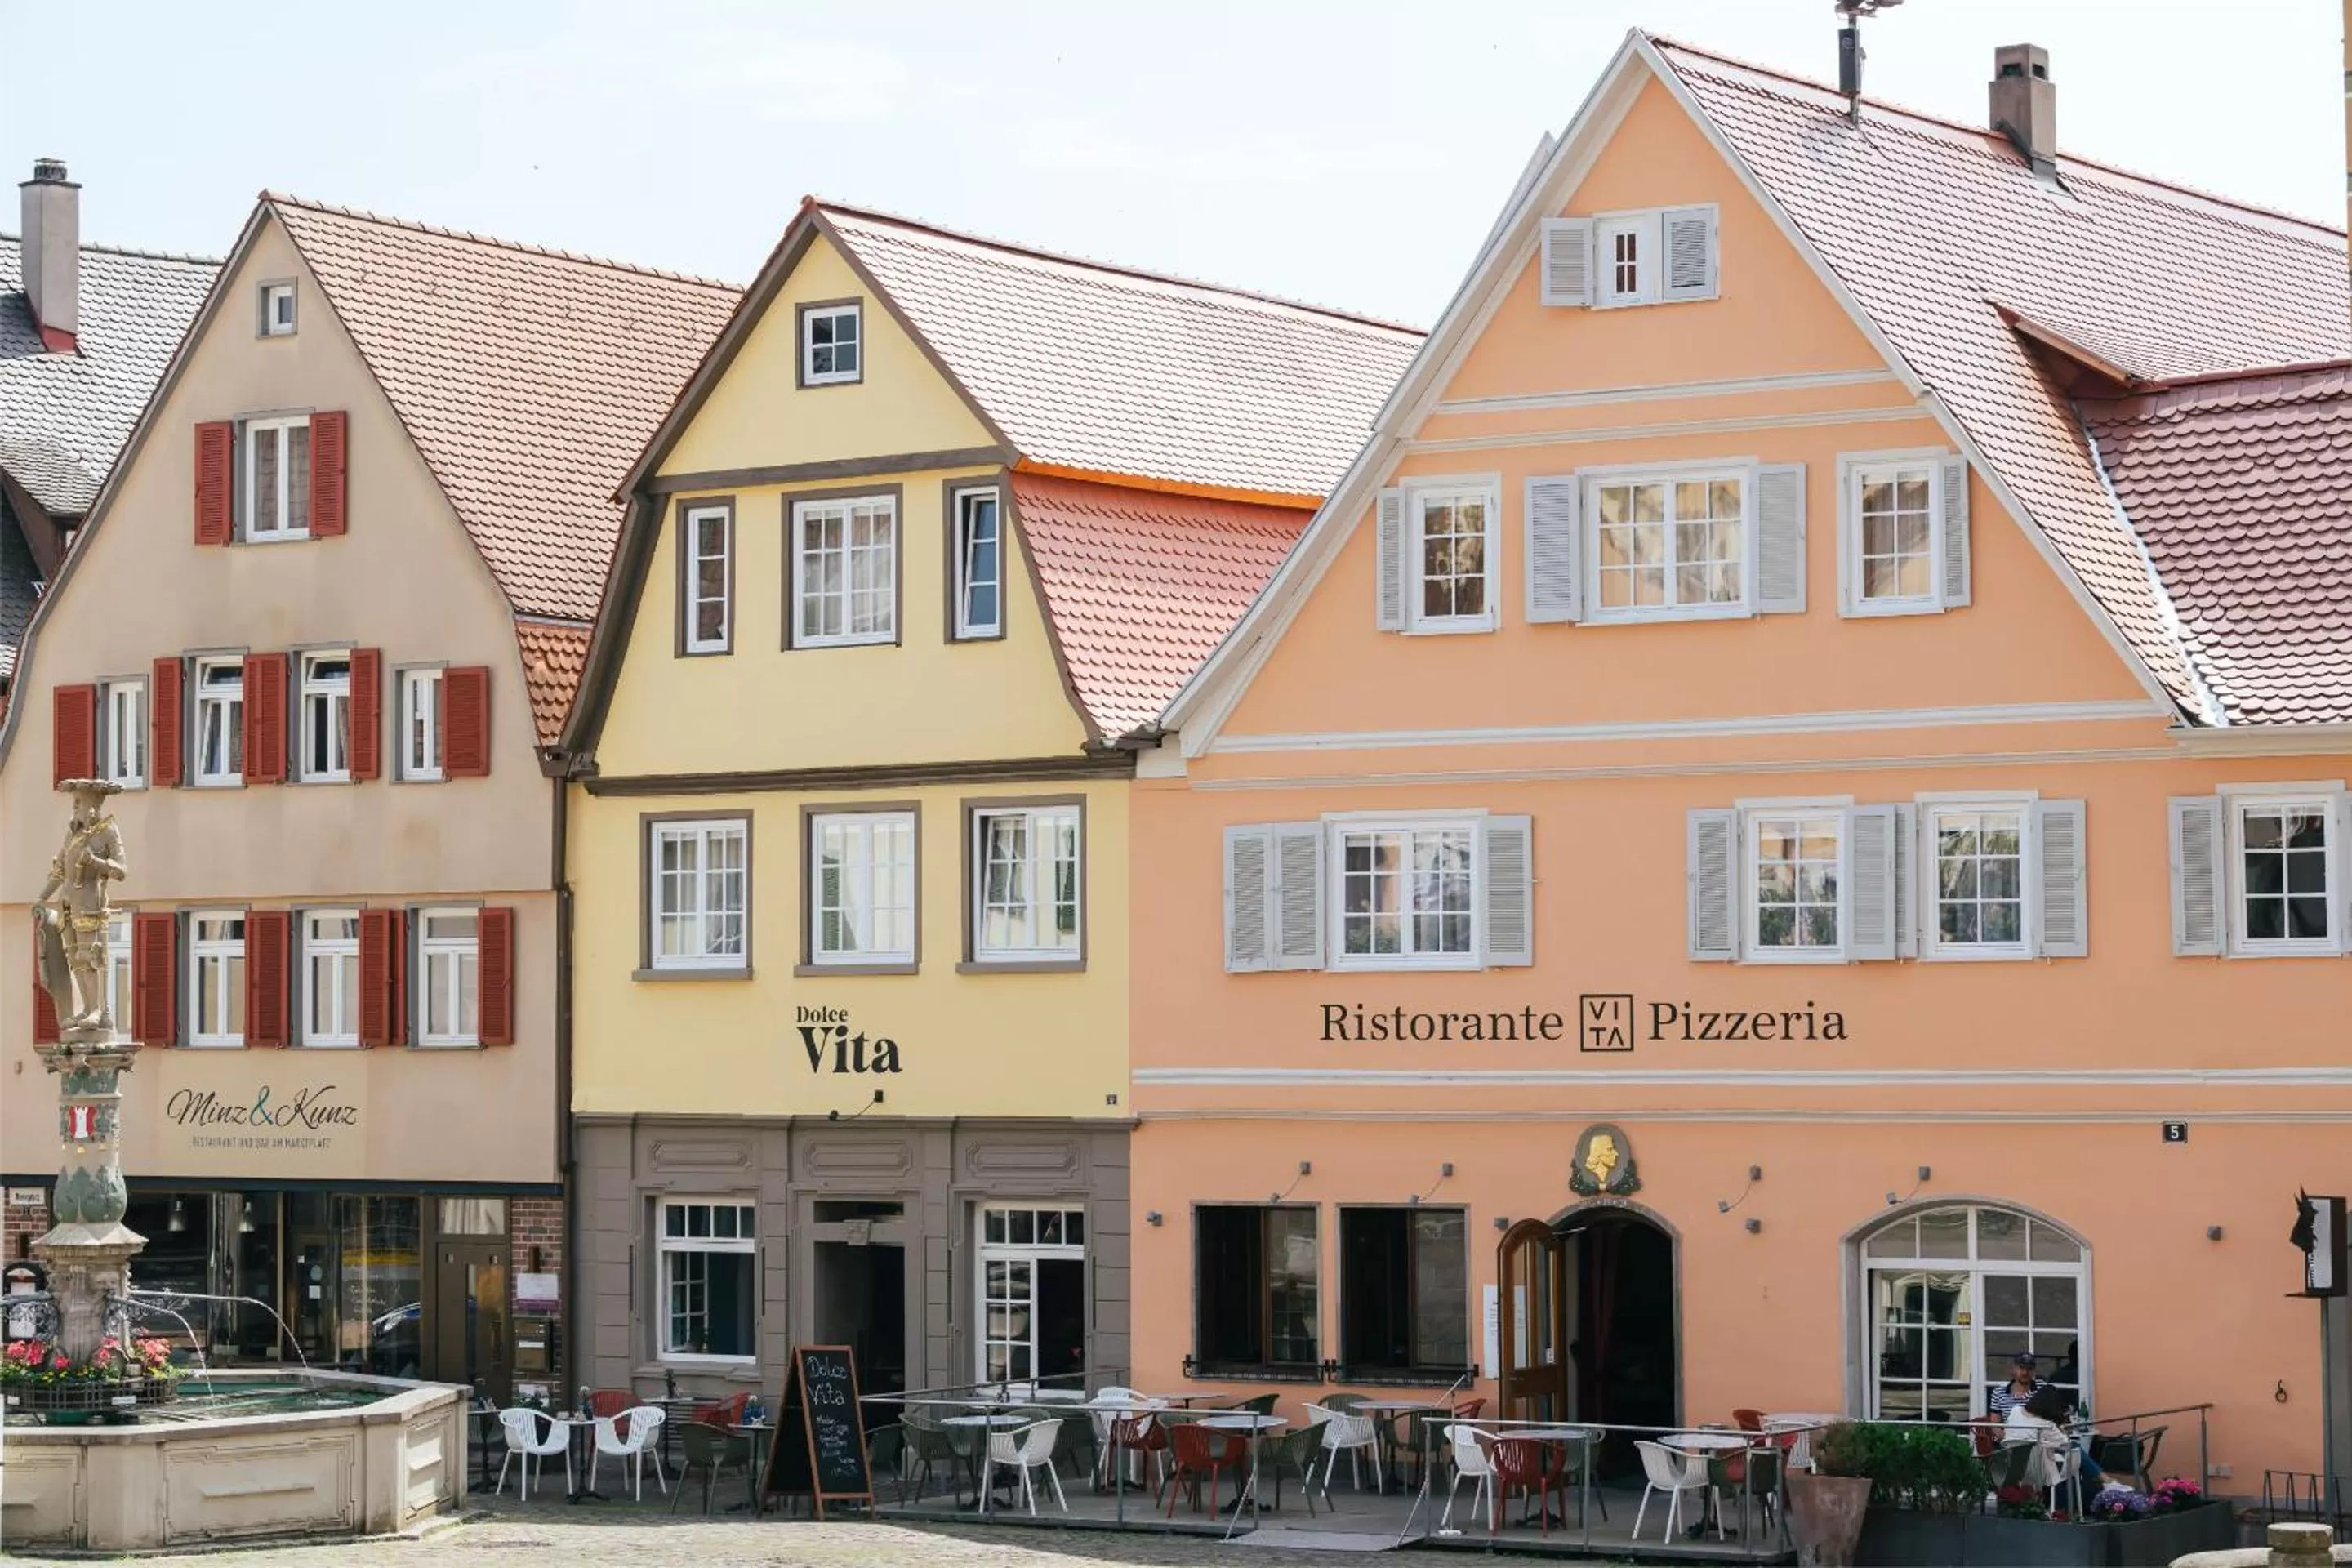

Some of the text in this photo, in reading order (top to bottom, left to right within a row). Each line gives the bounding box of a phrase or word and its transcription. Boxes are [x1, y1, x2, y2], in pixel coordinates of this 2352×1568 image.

[796, 1005, 849, 1022] Dolce
[1320, 1001, 1849, 1041] Ristorante Pizzeria
[796, 1025, 902, 1073] Vita
[2171, 1125, 2179, 1138] 5
[804, 1356, 848, 1379] Dolce
[807, 1382, 845, 1405] Vita
